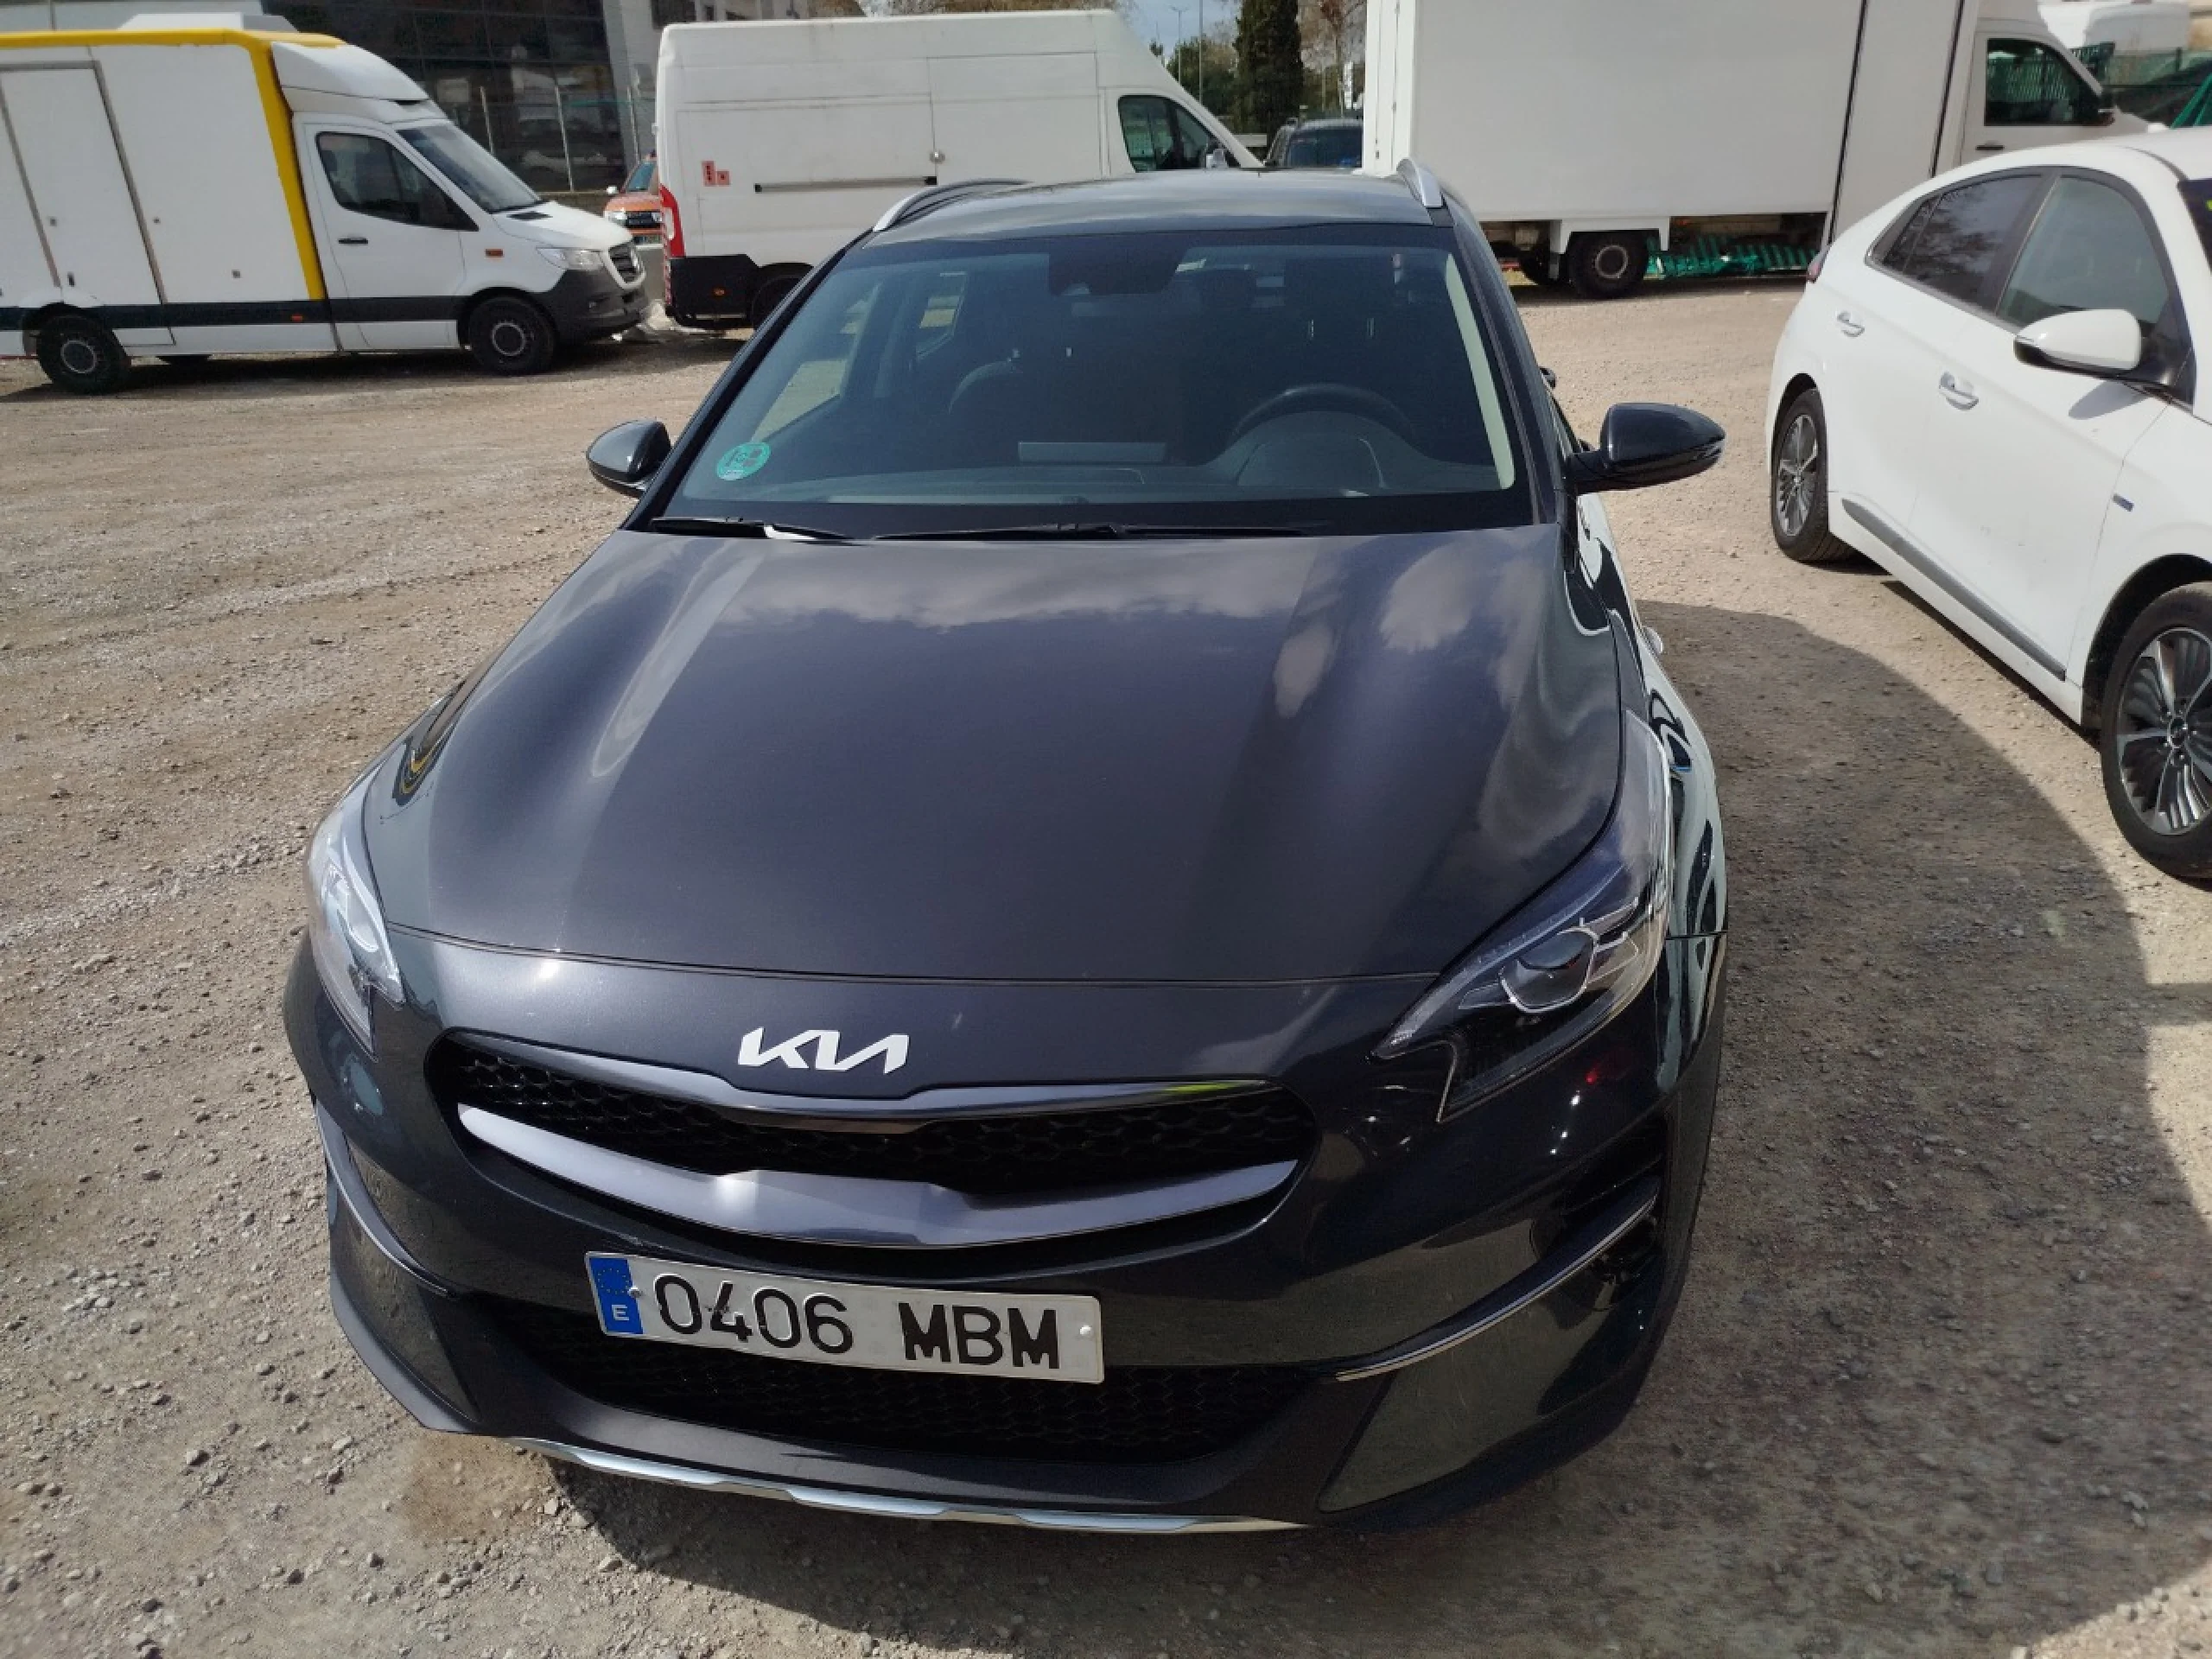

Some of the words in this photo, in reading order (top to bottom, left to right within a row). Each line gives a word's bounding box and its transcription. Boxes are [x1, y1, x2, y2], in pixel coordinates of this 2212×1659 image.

[738, 1027, 909, 1073] KIA
[612, 1304, 630, 1321] E
[654, 1273, 854, 1353] 0406
[899, 1302, 1061, 1370] MBM
